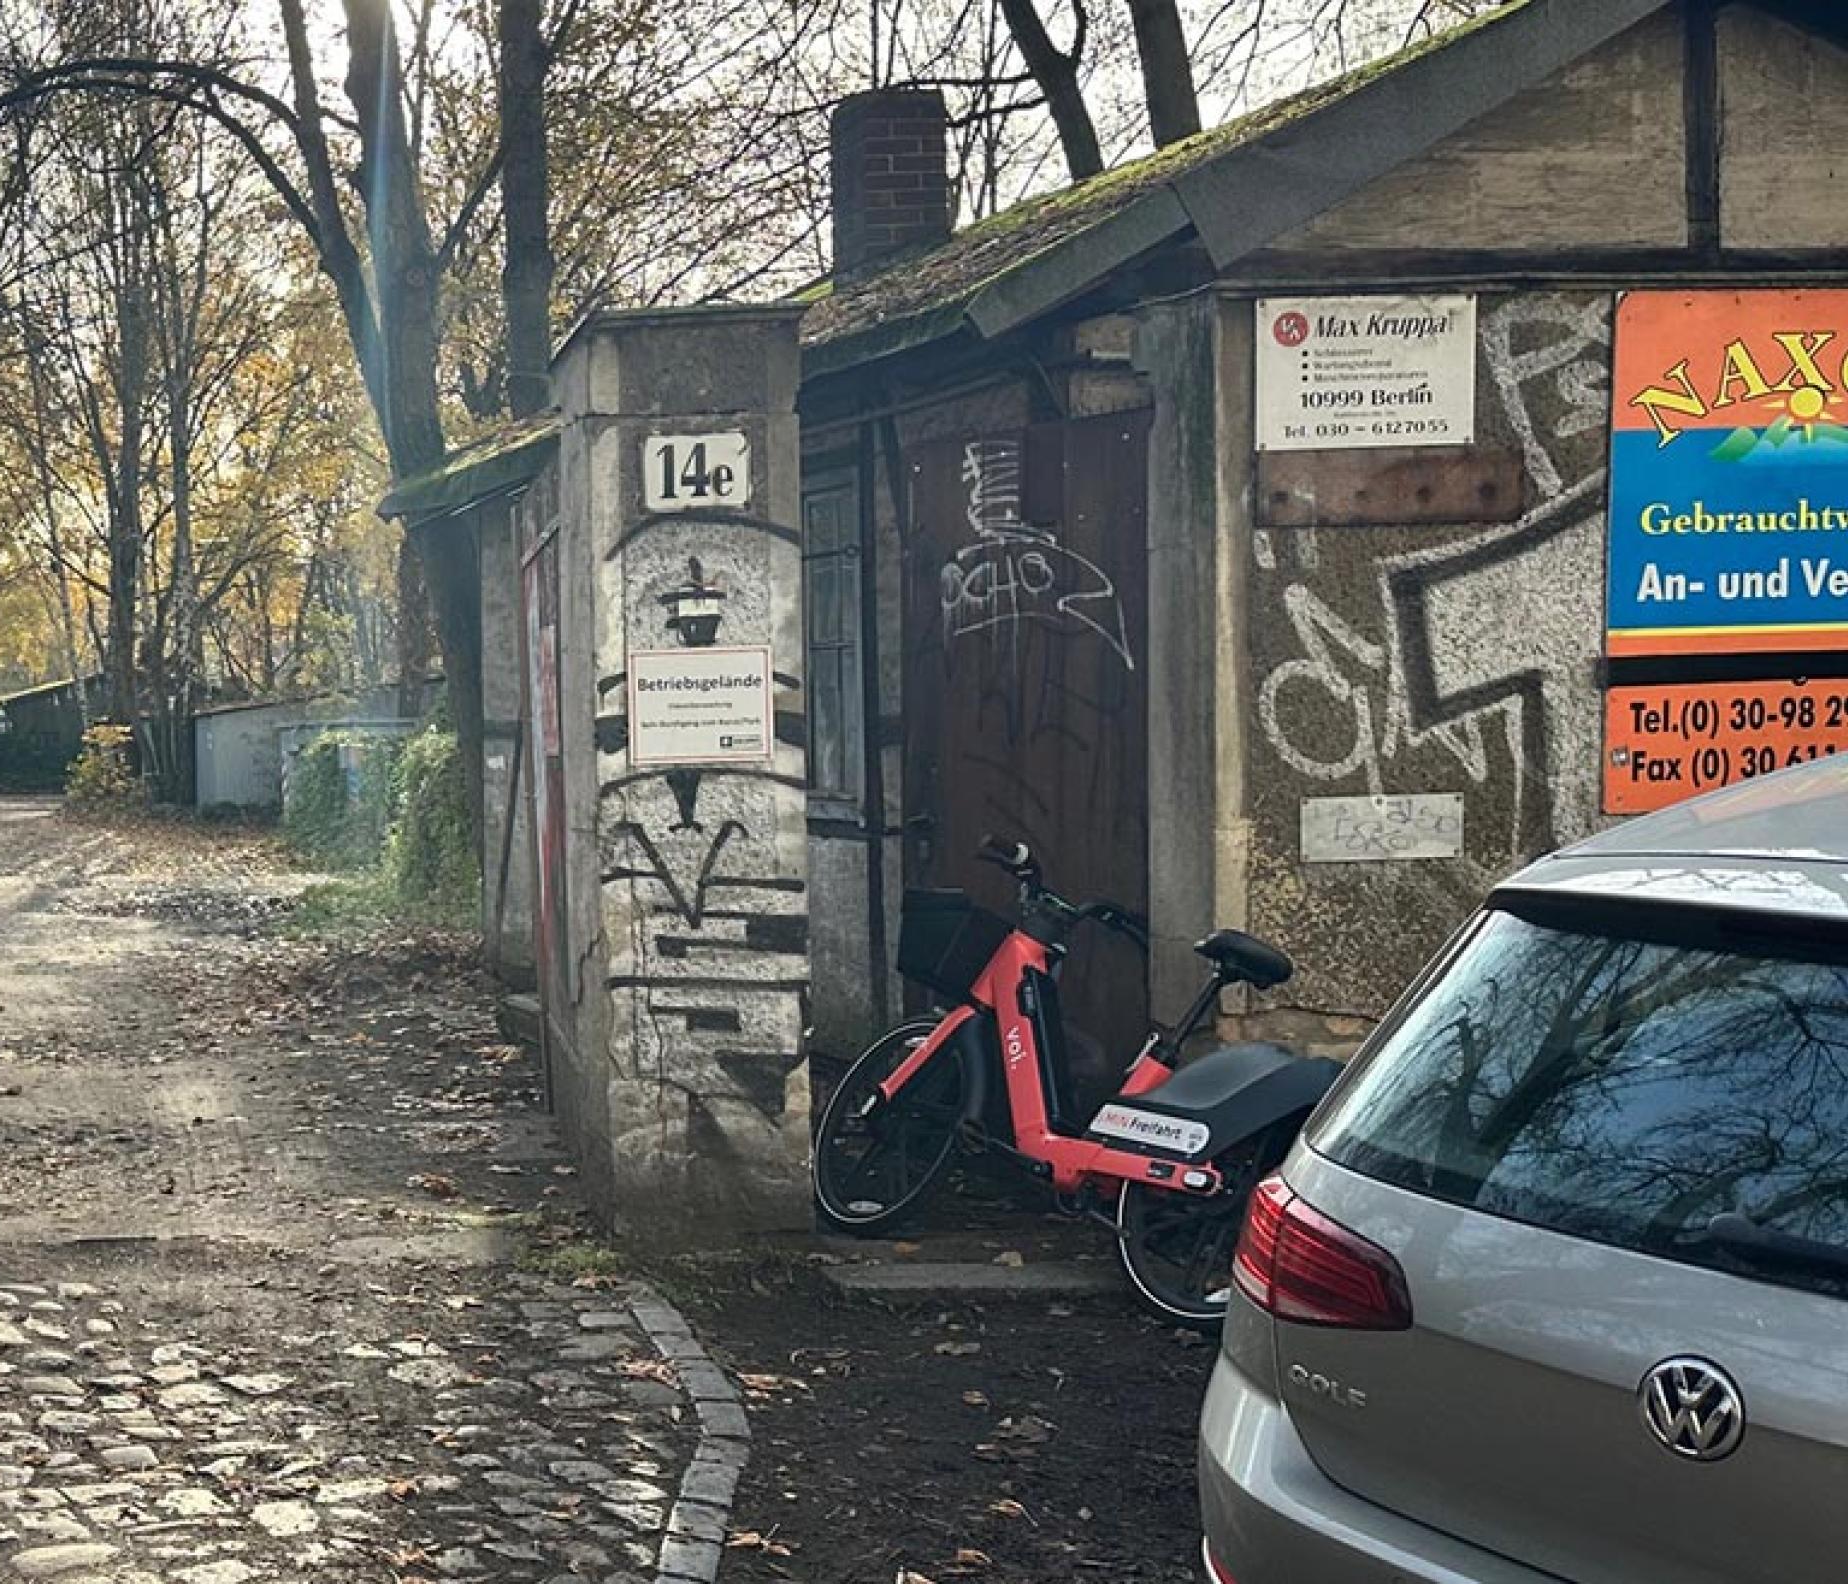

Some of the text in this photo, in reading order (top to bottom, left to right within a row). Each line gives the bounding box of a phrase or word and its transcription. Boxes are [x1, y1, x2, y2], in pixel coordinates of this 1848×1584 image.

[1316, 314, 1359, 338] Max
[1365, 311, 1448, 340] Kruppa
[1300, 386, 1434, 409] 10999 Berlin
[1628, 331, 1848, 448] NAX
[1315, 423, 1350, 438] 030
[656, 442, 735, 499] 14e
[1636, 557, 1848, 602] An- und Ve
[637, 674, 762, 693] Betriebsgelände
[1729, 695, 1816, 730] 30-98
[1824, 694, 1848, 728] 2
[1631, 751, 1682, 782] Fax
[1691, 748, 1730, 788] (0)
[1740, 745, 1776, 778] 30
